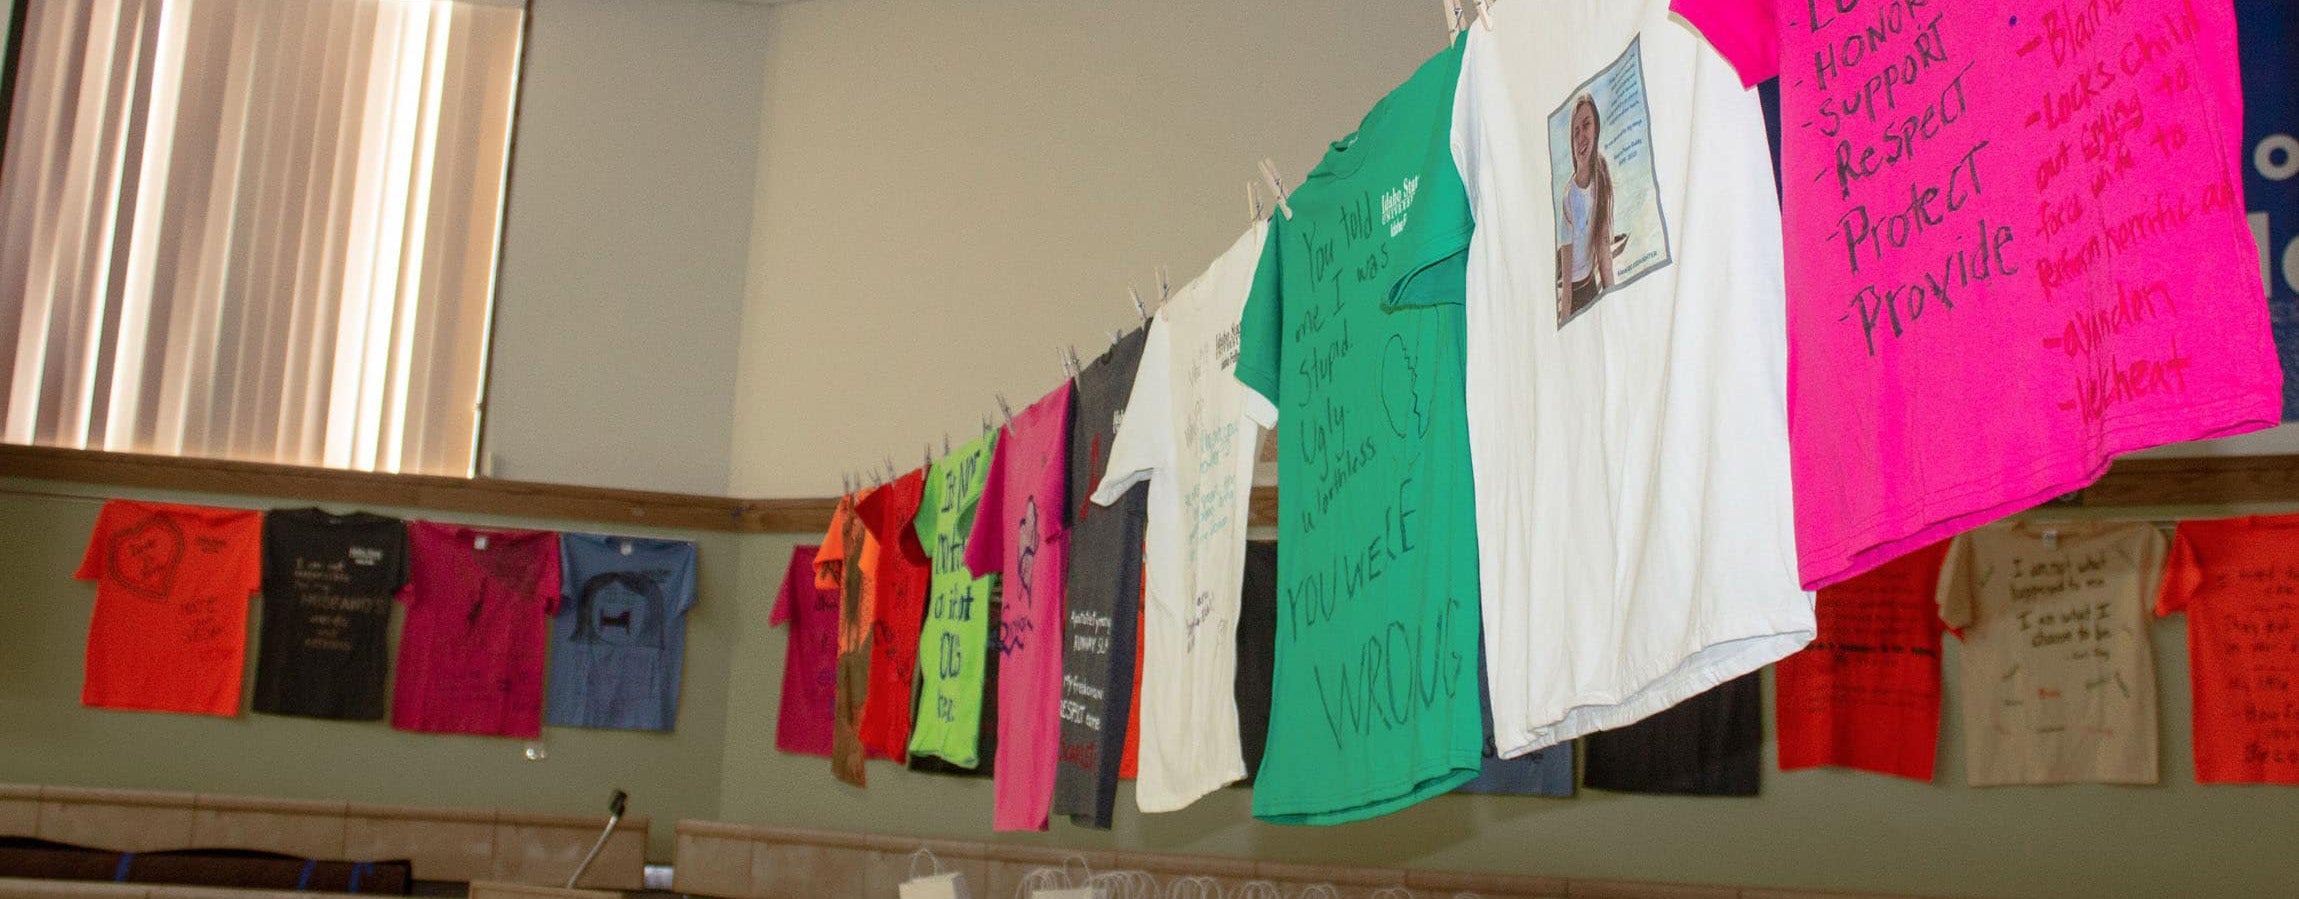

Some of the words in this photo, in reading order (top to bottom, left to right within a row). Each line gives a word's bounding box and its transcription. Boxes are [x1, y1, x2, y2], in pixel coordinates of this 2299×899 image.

[1403, 174, 1420, 197] Stat
[1303, 220, 1336, 293] You
[1340, 190, 1373, 250] told
[1296, 304, 1326, 344] me
[1332, 269, 1344, 316] I
[1357, 242, 1390, 284] was
[1287, 555, 1337, 643] YOU
